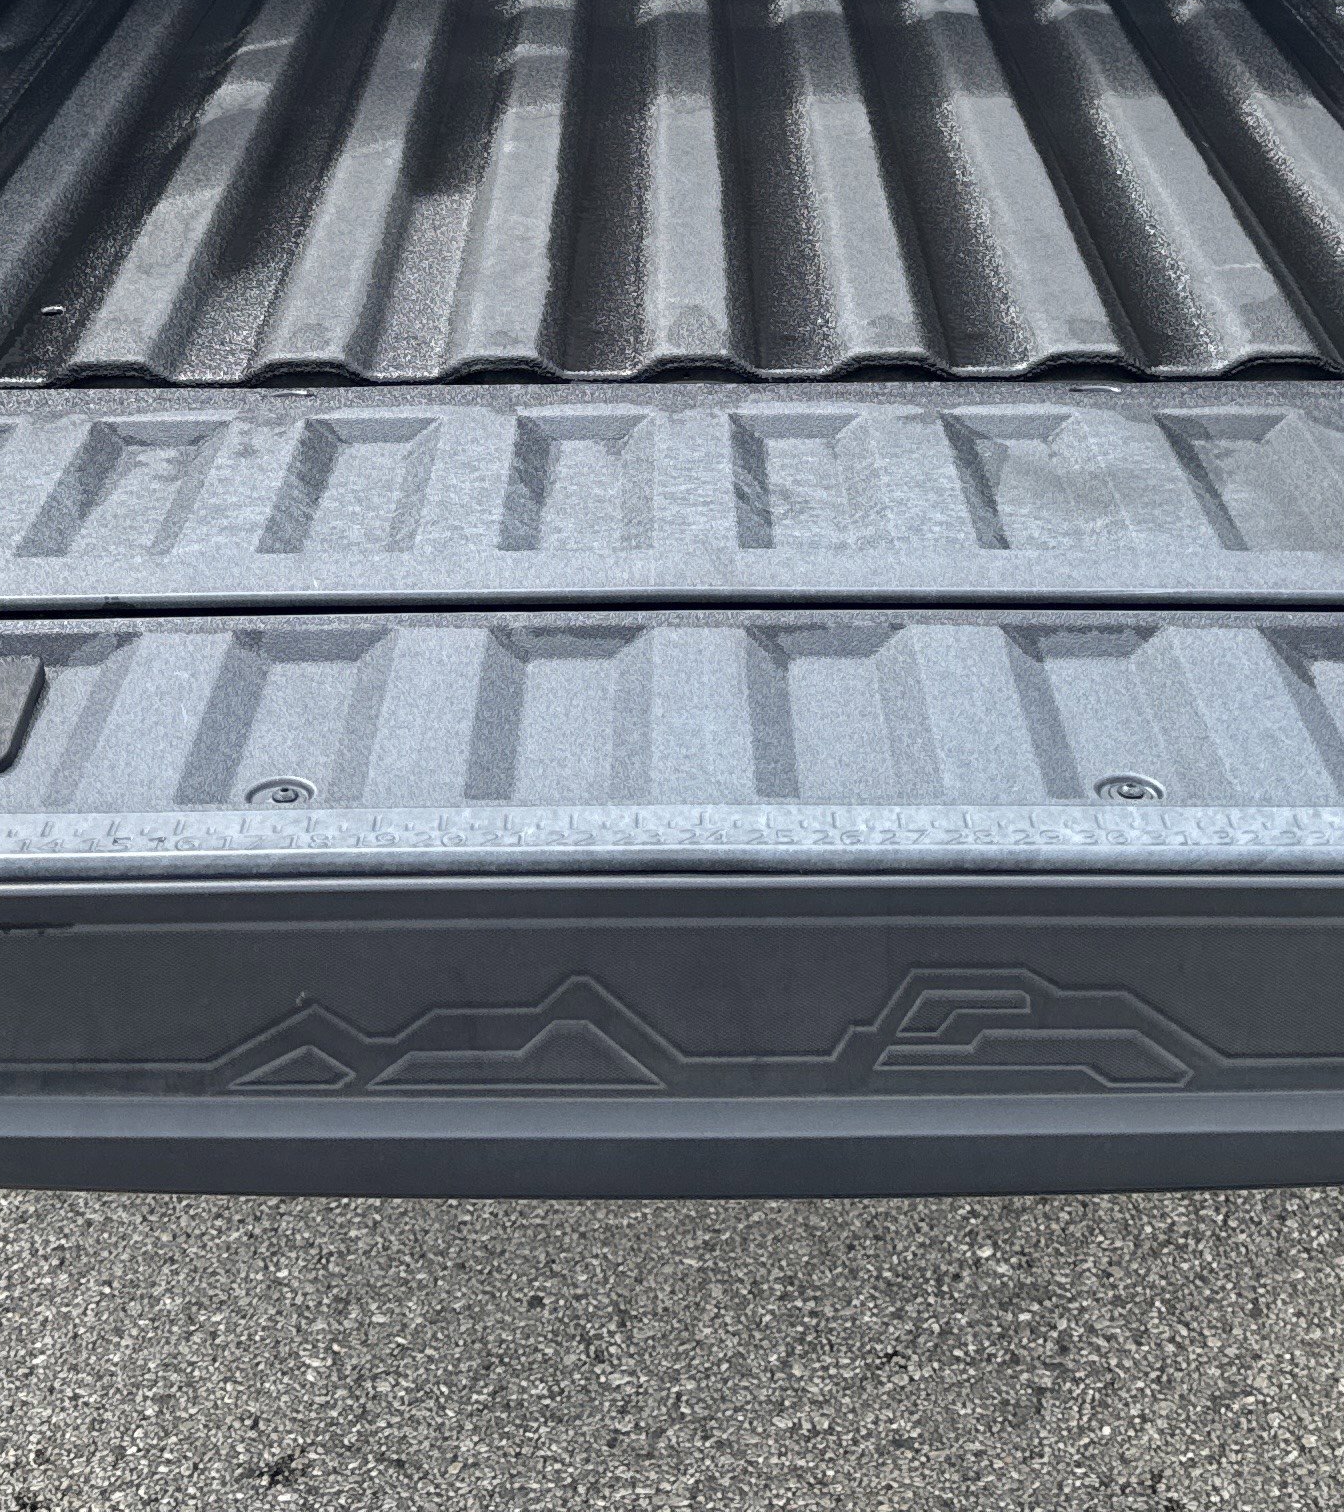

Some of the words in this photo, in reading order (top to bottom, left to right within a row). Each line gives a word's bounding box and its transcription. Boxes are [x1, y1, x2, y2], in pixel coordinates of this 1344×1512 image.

[17, 837, 62, 853] 14
[85, 837, 133, 852] 15
[148, 836, 200, 852] 16
[283, 834, 333, 848] 18
[356, 833, 401, 847] 19
[411, 833, 468, 847] 20
[479, 831, 528, 846] 21
[546, 830, 595, 846] 22
[612, 830, 662, 845] 23
[678, 829, 728, 844] 24
[746, 829, 795, 844] 25
[812, 829, 862, 844] 26
[879, 829, 930, 844] 27
[945, 829, 995, 844] 28
[1012, 829, 1064, 844] 29
[1078, 829, 1129, 845] 30
[1144, 829, 1198, 845] 31
